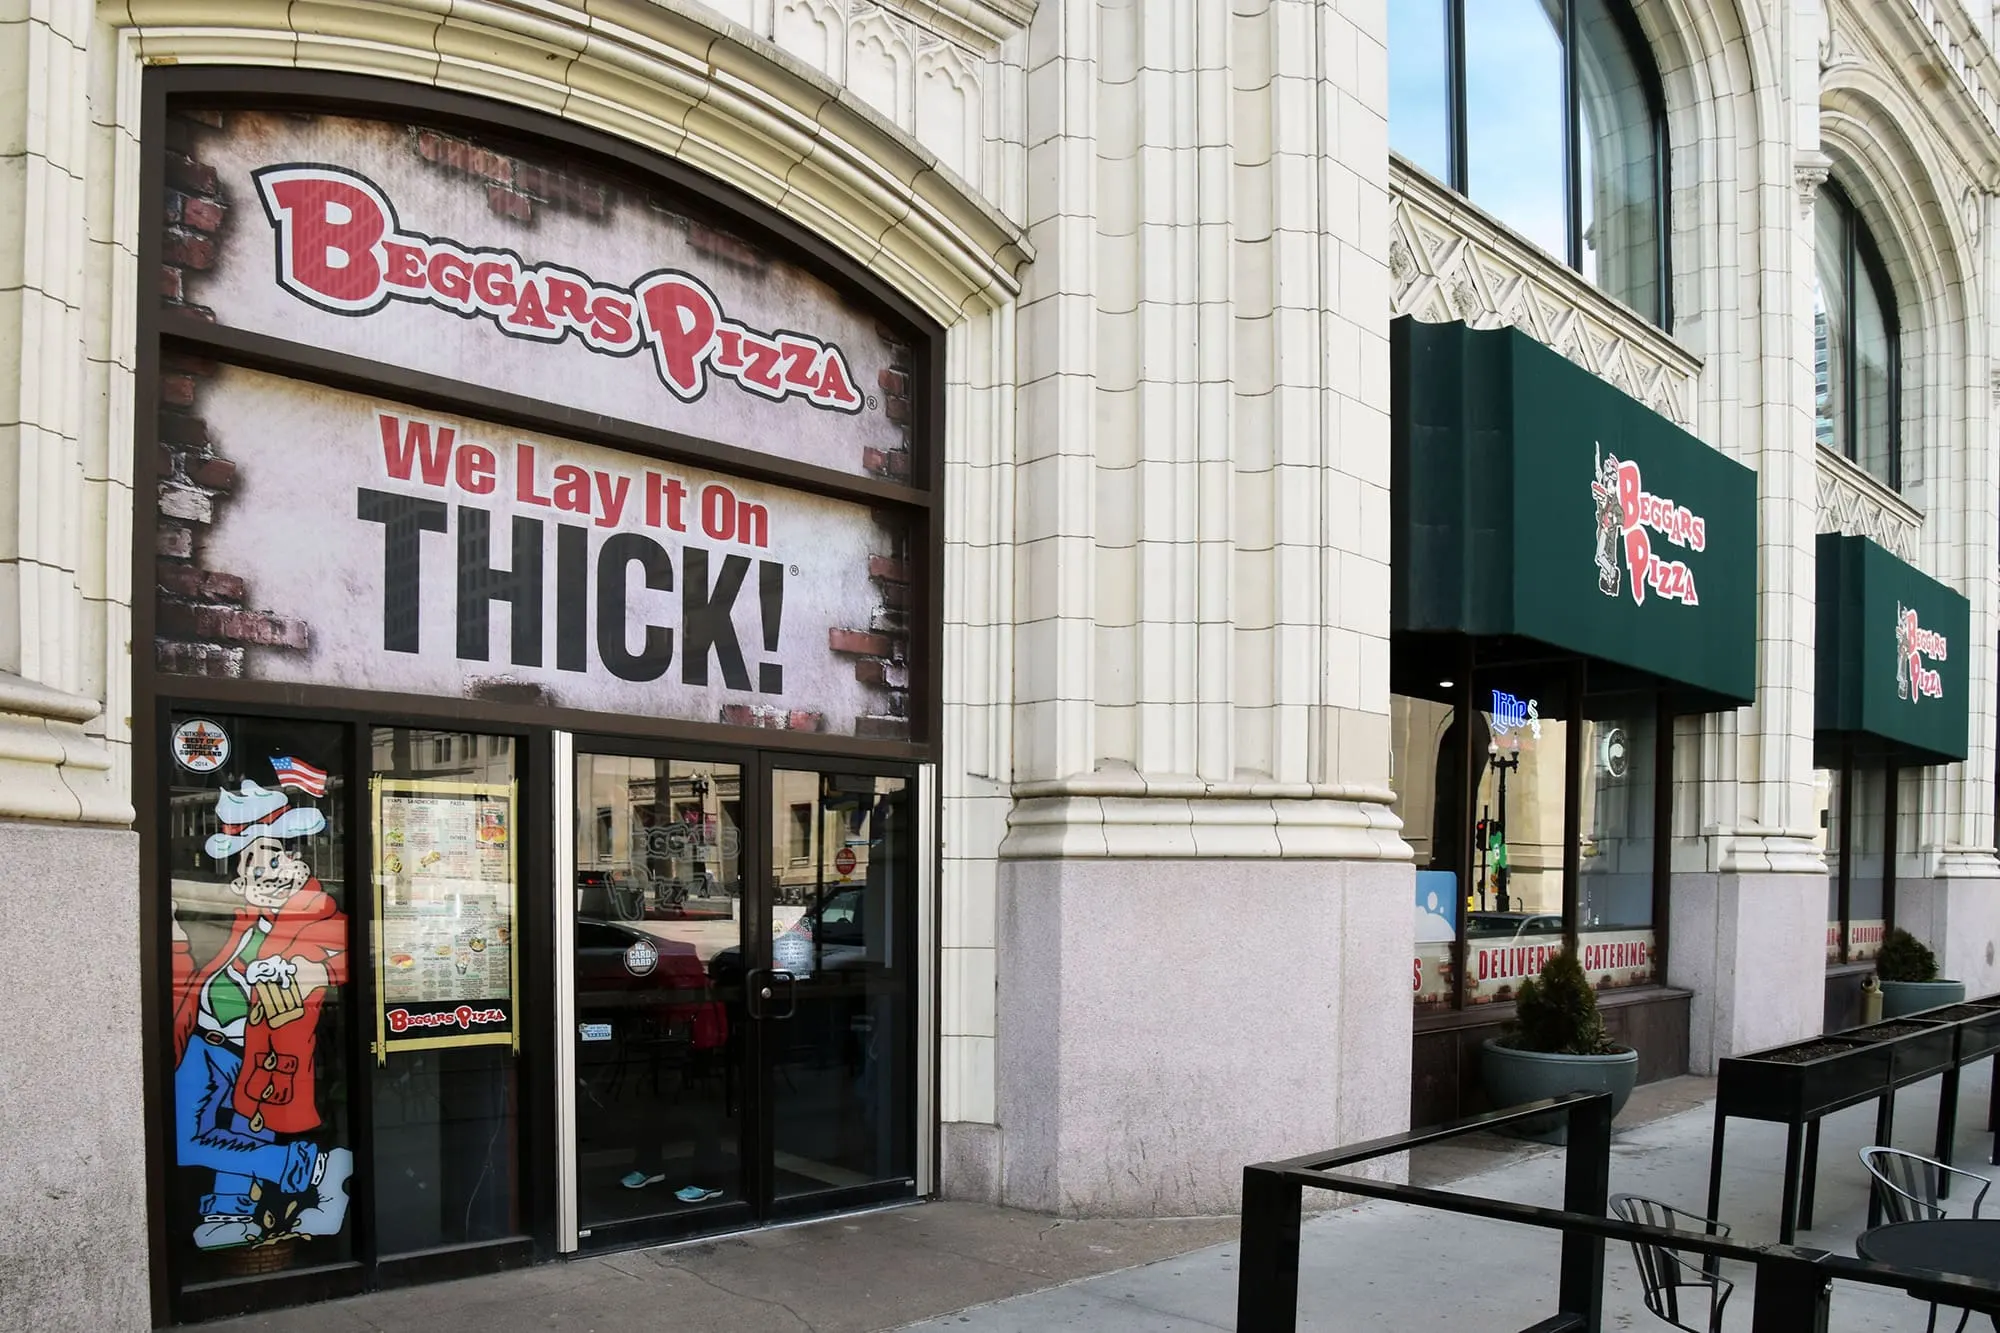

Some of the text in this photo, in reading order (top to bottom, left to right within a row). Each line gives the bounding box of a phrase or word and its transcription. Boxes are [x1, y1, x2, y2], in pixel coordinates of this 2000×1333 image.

[270, 175, 859, 406] BEGGARS PIZZA
[377, 412, 769, 549] We Lay It On
[1618, 464, 1704, 549] BEGGARS
[1626, 528, 1697, 602] PIZZA
[357, 486, 786, 696] THICK!
[1907, 612, 1945, 659] BEGGARS
[1910, 652, 1942, 700] PIZZA
[1491, 689, 1527, 735] Lite
[629, 950, 651, 959] CARD
[630, 958, 651, 967] HARD
[1584, 941, 1646, 971] CATERING
[388, 1006, 505, 1032] BEGGARS PIZZA
